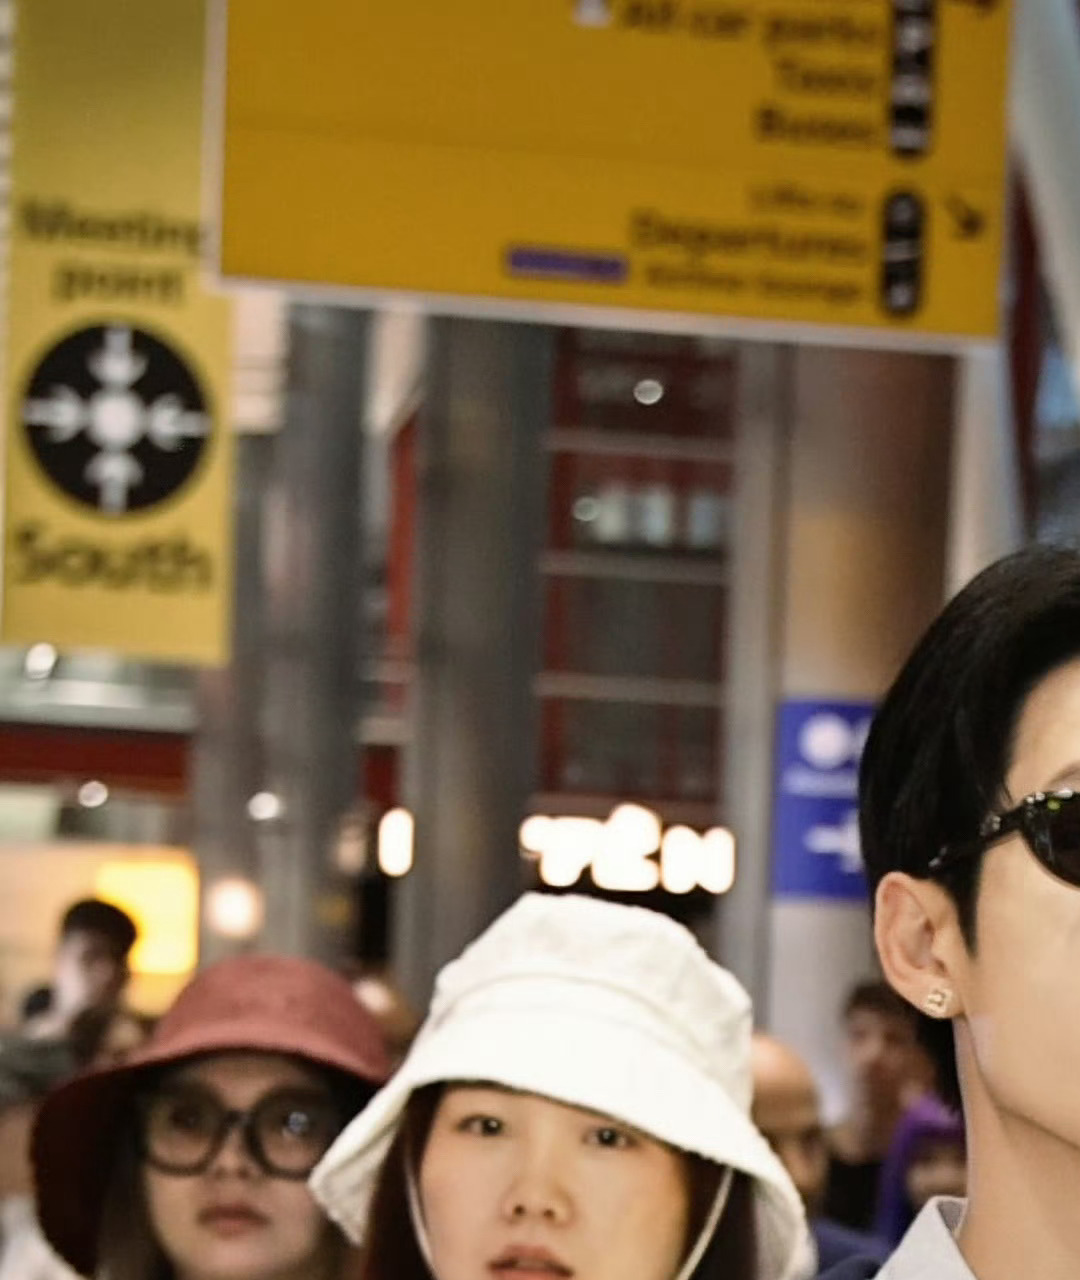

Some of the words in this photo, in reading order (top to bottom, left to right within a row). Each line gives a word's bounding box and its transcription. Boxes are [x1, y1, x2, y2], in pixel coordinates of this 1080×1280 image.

[20, 195, 206, 257] Meeting
[57, 260, 184, 305] point
[13, 520, 213, 595] South
